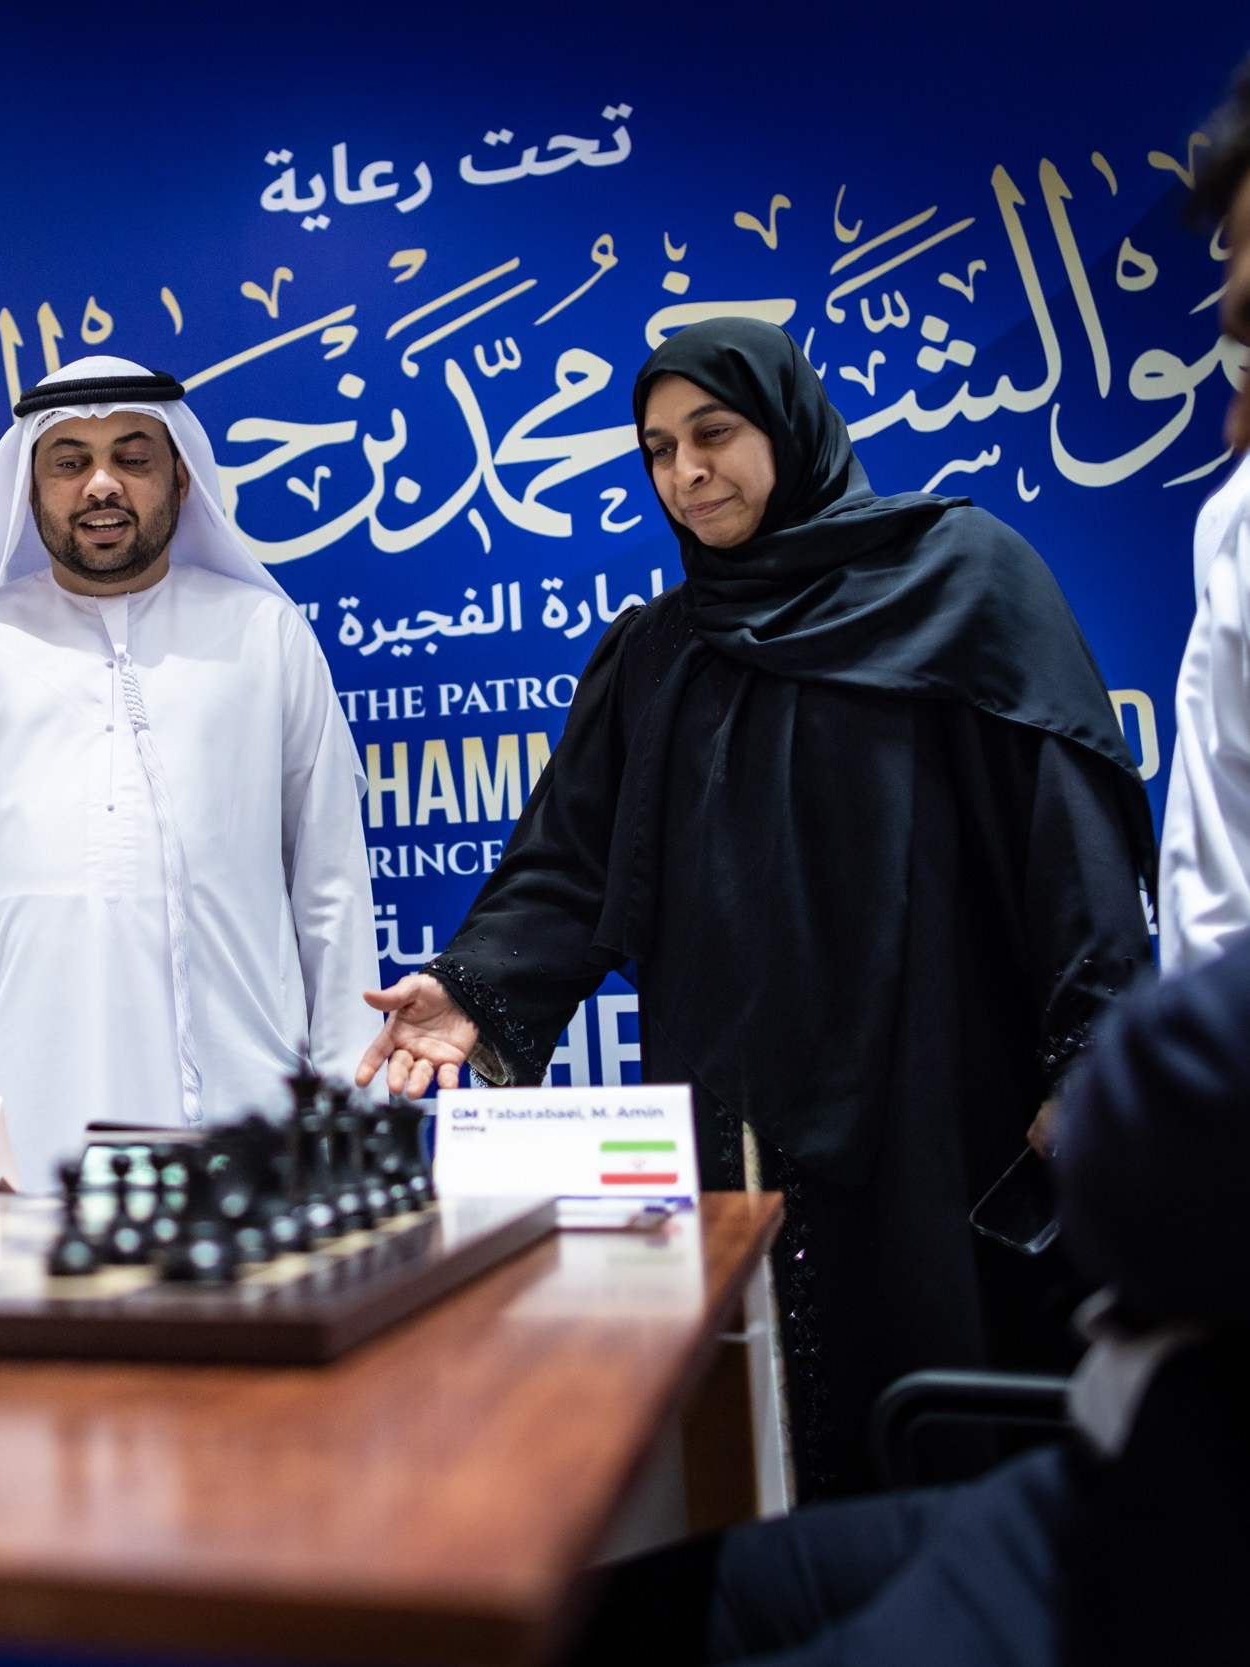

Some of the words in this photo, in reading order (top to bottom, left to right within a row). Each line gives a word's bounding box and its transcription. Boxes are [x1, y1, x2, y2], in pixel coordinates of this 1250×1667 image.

[459, 102, 633, 186] تحت
[259, 141, 433, 232] رعاية
[338, 580, 522, 657] الفجيرة
[338, 685, 426, 723] THE
[438, 673, 577, 717] PATRO
[368, 840, 503, 879] RINCE
[615, 1105, 665, 1120] Amin
